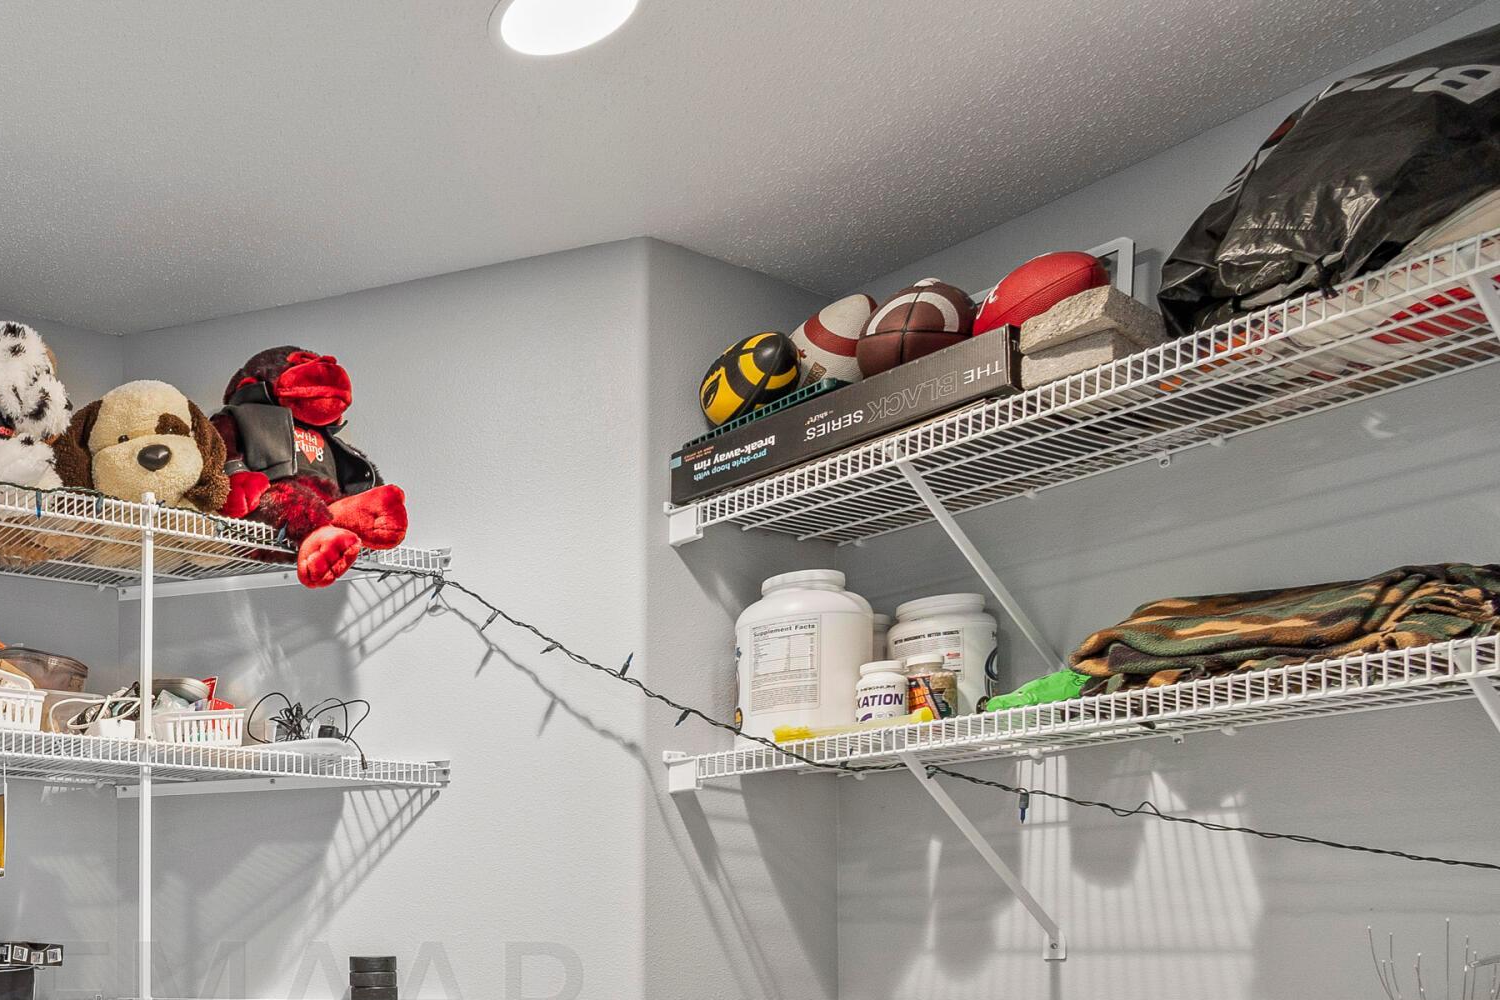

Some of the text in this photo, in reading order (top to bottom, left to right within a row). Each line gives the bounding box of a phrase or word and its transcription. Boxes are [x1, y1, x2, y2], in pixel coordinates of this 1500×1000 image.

[805, 360, 1003, 441] THE BLACK SERIES
[693, 448, 767, 481] pro-style hoop with
[693, 458, 712, 472] rim
[712, 434, 776, 465] break-away
[753, 623, 816, 638] Supplement Facts
